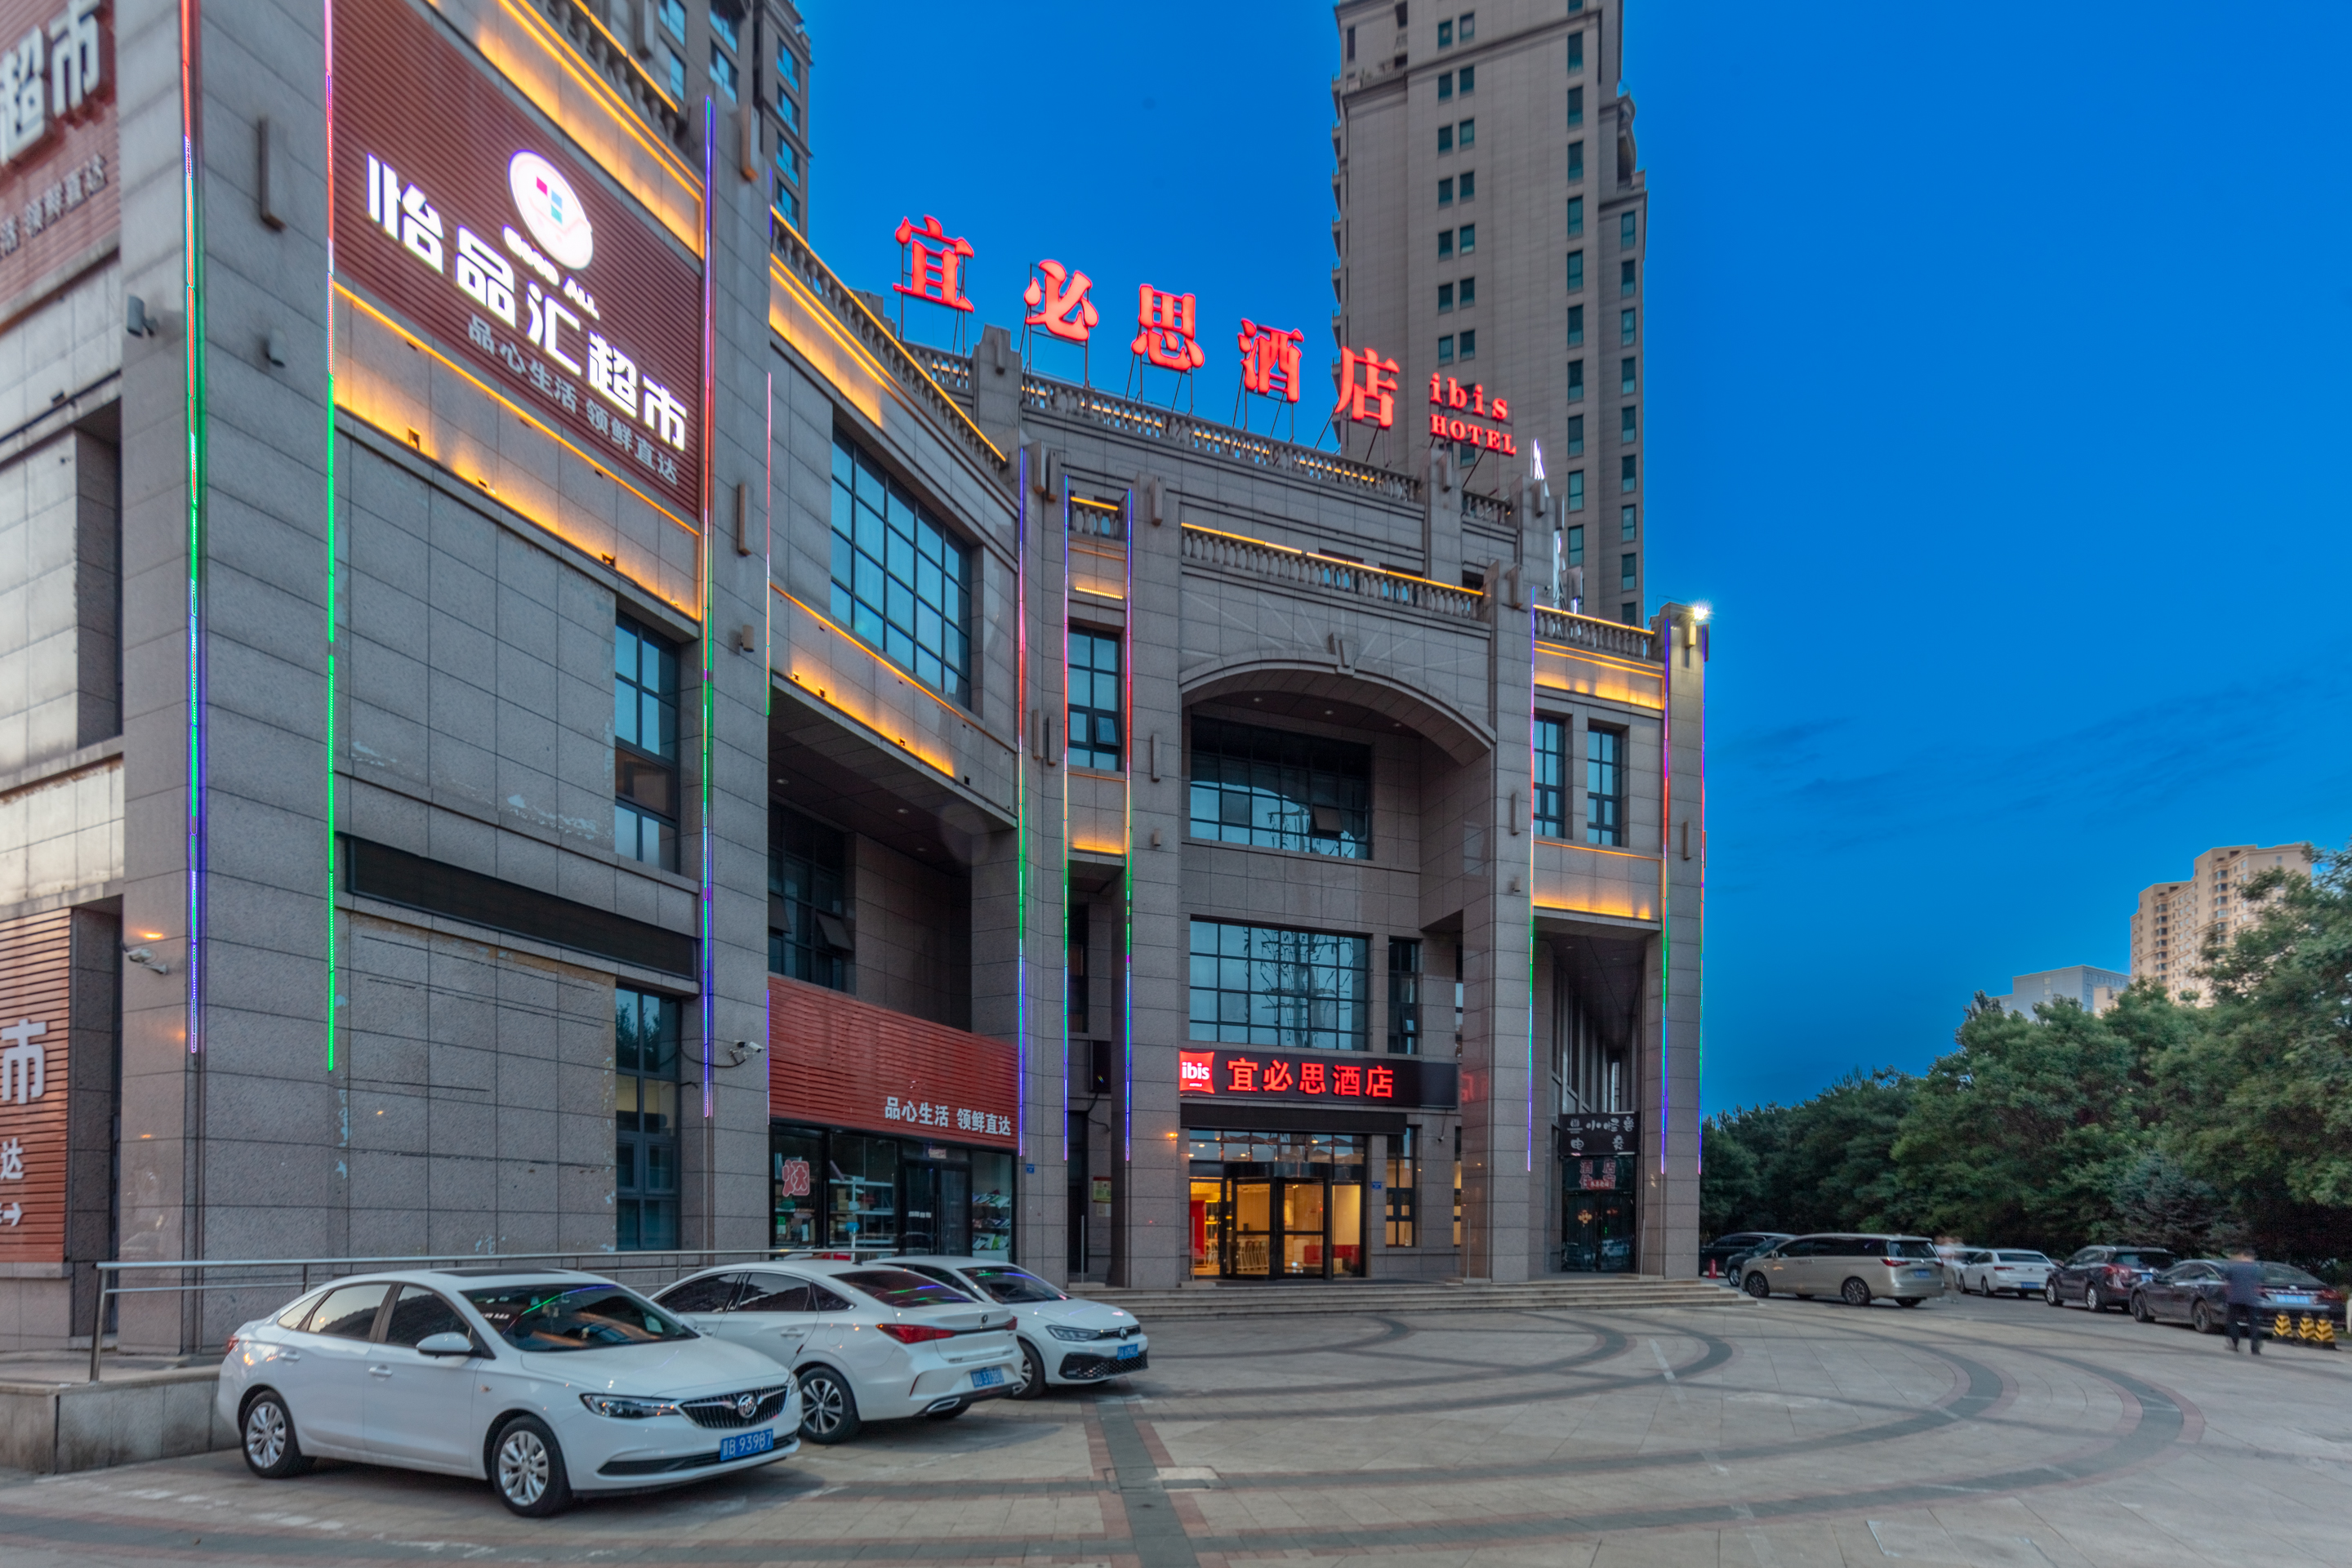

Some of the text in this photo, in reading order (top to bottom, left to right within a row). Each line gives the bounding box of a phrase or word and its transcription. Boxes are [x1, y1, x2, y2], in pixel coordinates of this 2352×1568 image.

[502, 225, 599, 320] GOOD ALL
[367, 152, 688, 451] 怡品汇超市
[893, 215, 1400, 428] 宜必思酒店
[468, 312, 677, 486] 品心生活 领鲜直达
[1430, 372, 1508, 419] ibis
[1431, 414, 1517, 454] HOTEL
[1, 1018, 47, 1104] 市
[1181, 1062, 1210, 1080] ibis
[1227, 1058, 1393, 1098] 宜必思酒店
[884, 1096, 1011, 1136] 品心生活 领鲜直达
[0, 1138, 24, 1179] 达
